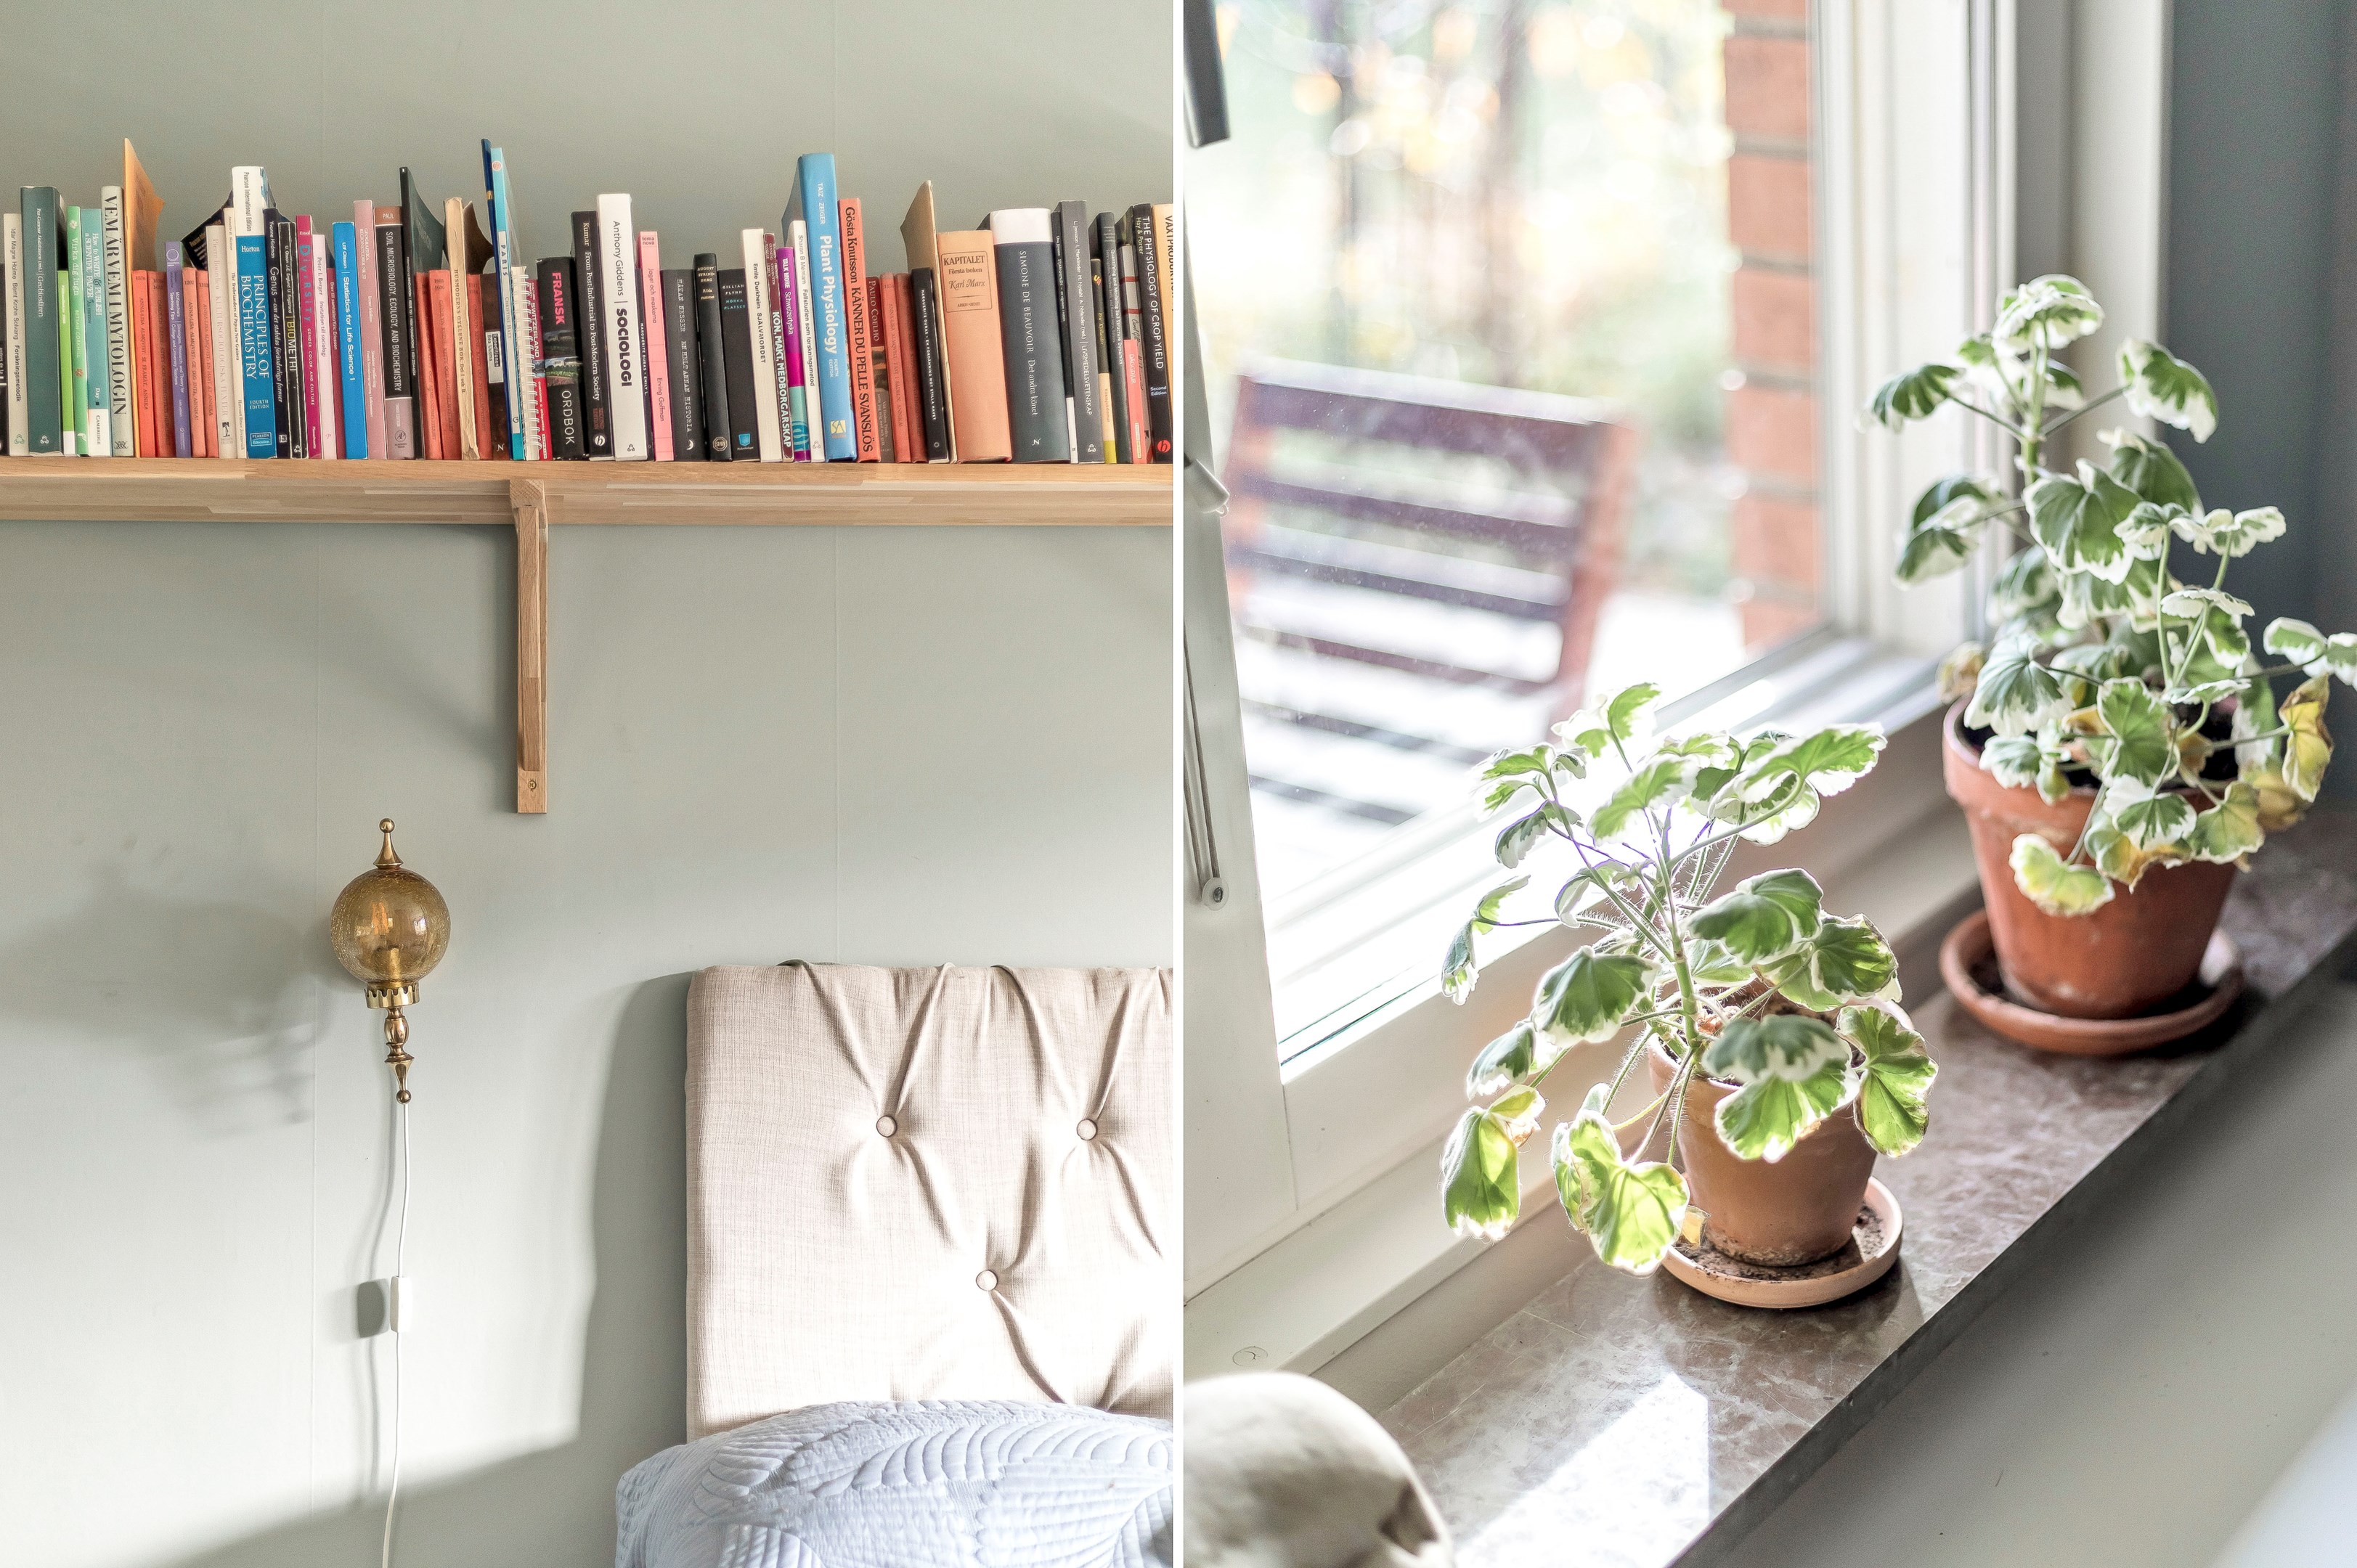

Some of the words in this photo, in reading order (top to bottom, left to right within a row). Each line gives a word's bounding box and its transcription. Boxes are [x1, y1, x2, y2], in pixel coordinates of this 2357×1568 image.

[105, 196, 118, 231] VEM
[845, 207, 855, 237] Gösta
[106, 236, 121, 256] ÄR
[820, 236, 832, 271] Plant
[848, 237, 858, 283] Knutsson
[944, 256, 985, 266] KAPITALET
[1019, 250, 1029, 287] SIMONE
[1144, 238, 1157, 297] PHYSIOLOGY
[107, 260, 121, 295] VEM
[270, 267, 279, 295] Genus
[343, 277, 352, 312] Statistics
[552, 272, 565, 324] FRANSK
[586, 272, 595, 321] Post-Industrial
[616, 260, 624, 295] Giddens
[949, 280, 964, 290] Karl
[966, 279, 985, 287] Marx
[1023, 292, 1030, 302] DE
[241, 276, 256, 379] BIOCHEMISTRY
[253, 275, 268, 354] PRINCIPLES
[273, 303, 277, 312] om
[387, 248, 396, 296] MICROBIOLOGY,
[392, 345, 402, 391] BIOCHEMISTRY
[784, 291, 794, 335] Schweizertyska
[821, 276, 838, 354] Physiology
[852, 287, 863, 334] KÄNNER
[1150, 301, 1158, 312] OF
[287, 322, 297, 371] BIOMETRI
[616, 309, 632, 386] SOCIOLOGI
[855, 337, 866, 353] DU
[1024, 307, 1033, 353] BEAUVOIR
[110, 311, 126, 415] MYTOLOGIN
[259, 359, 269, 378] OF
[806, 337, 815, 386] forskningsmetod
[857, 356, 868, 390] PELLE
[1082, 346, 1092, 415] LIVSMEDELSVETENSKAP
[562, 391, 574, 444] ORDBOK
[777, 363, 791, 447] MEDBORGARSKAP
[859, 393, 874, 452] SVANSLÖS
